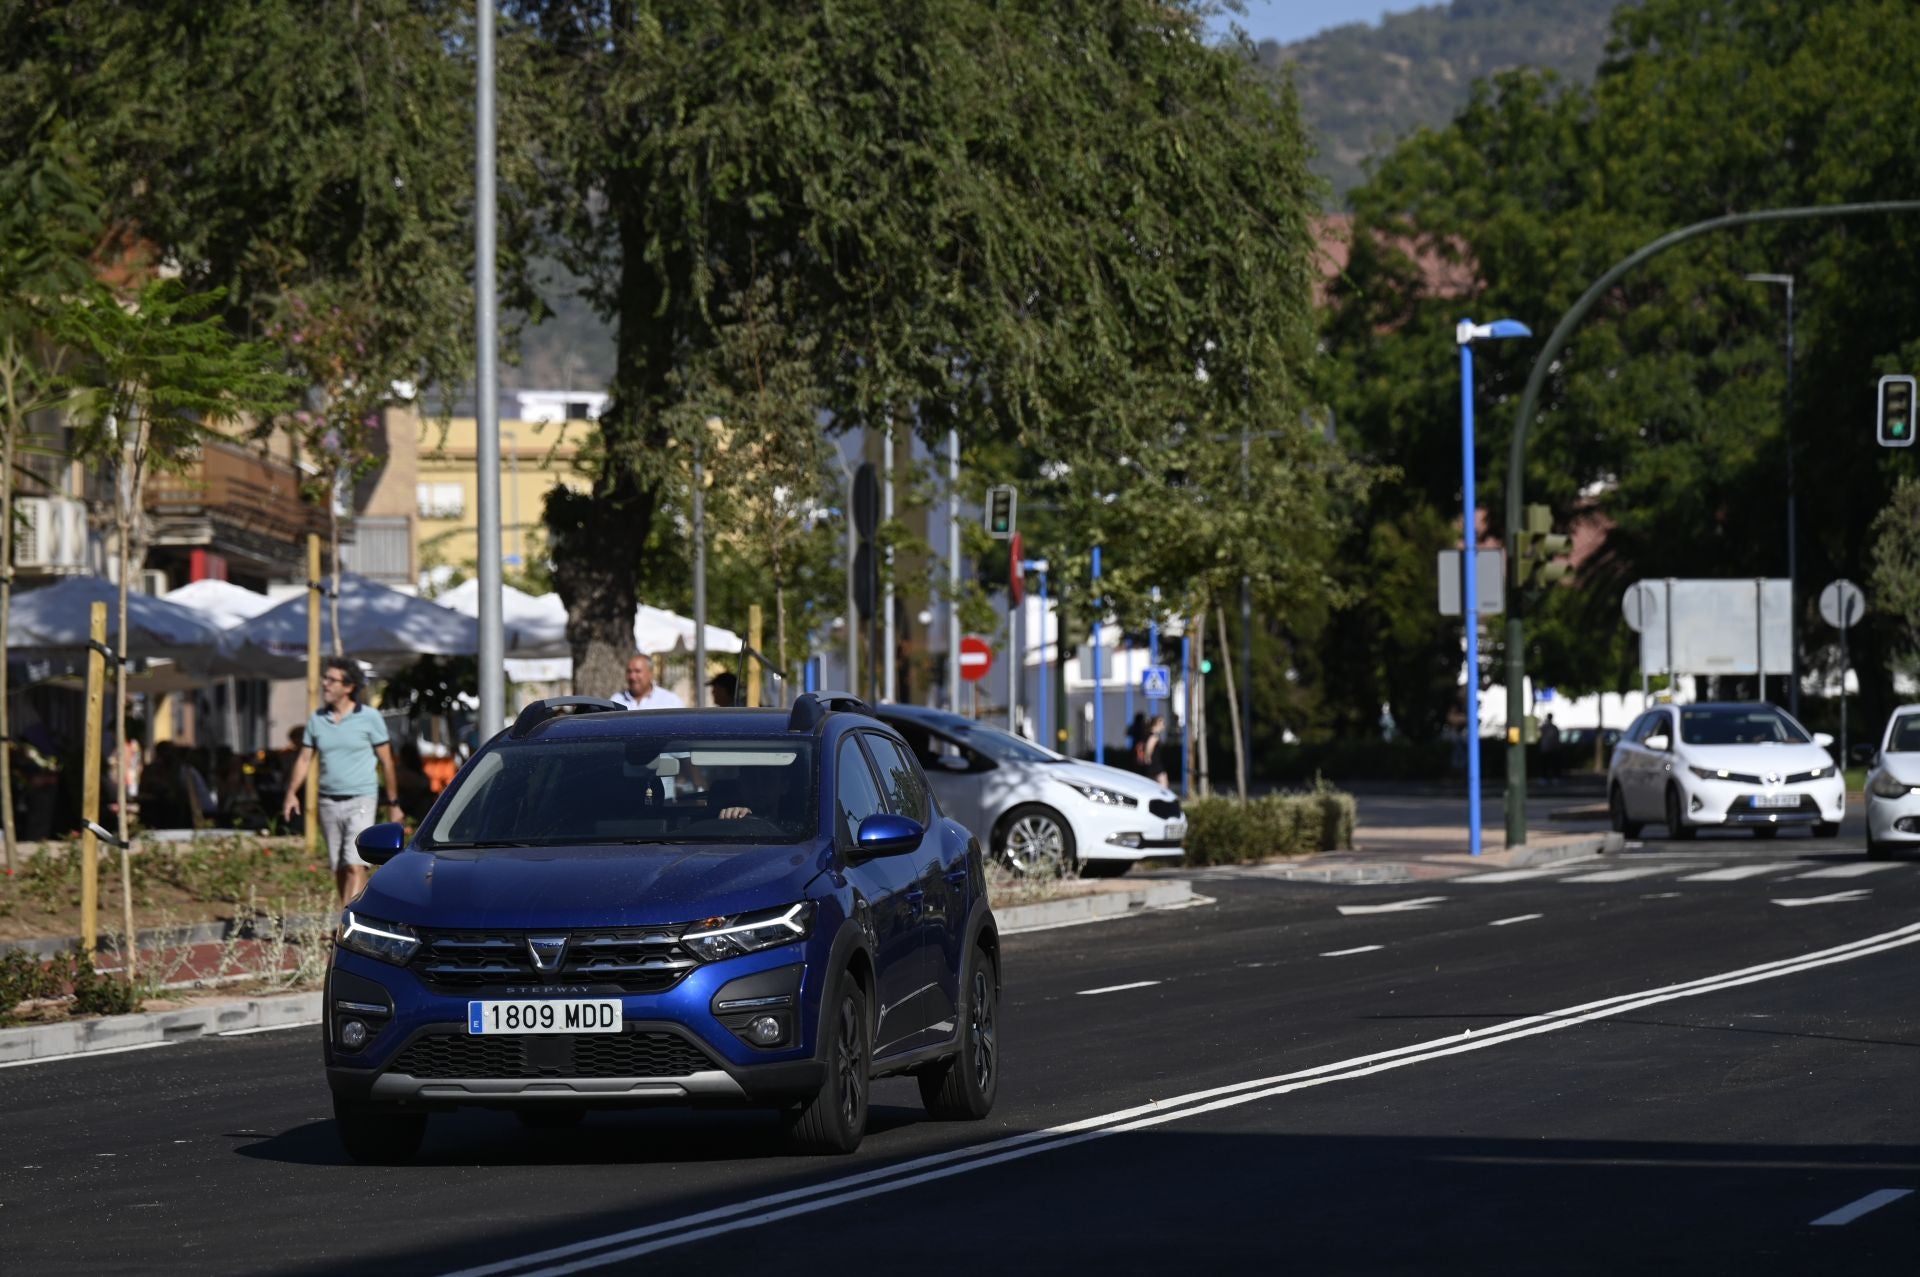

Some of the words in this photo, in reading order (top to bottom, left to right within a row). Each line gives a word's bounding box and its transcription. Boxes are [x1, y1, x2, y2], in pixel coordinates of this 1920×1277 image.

[473, 1020, 479, 1028] E
[492, 1004, 554, 1029] 1809
[565, 1003, 614, 1028] MDD
